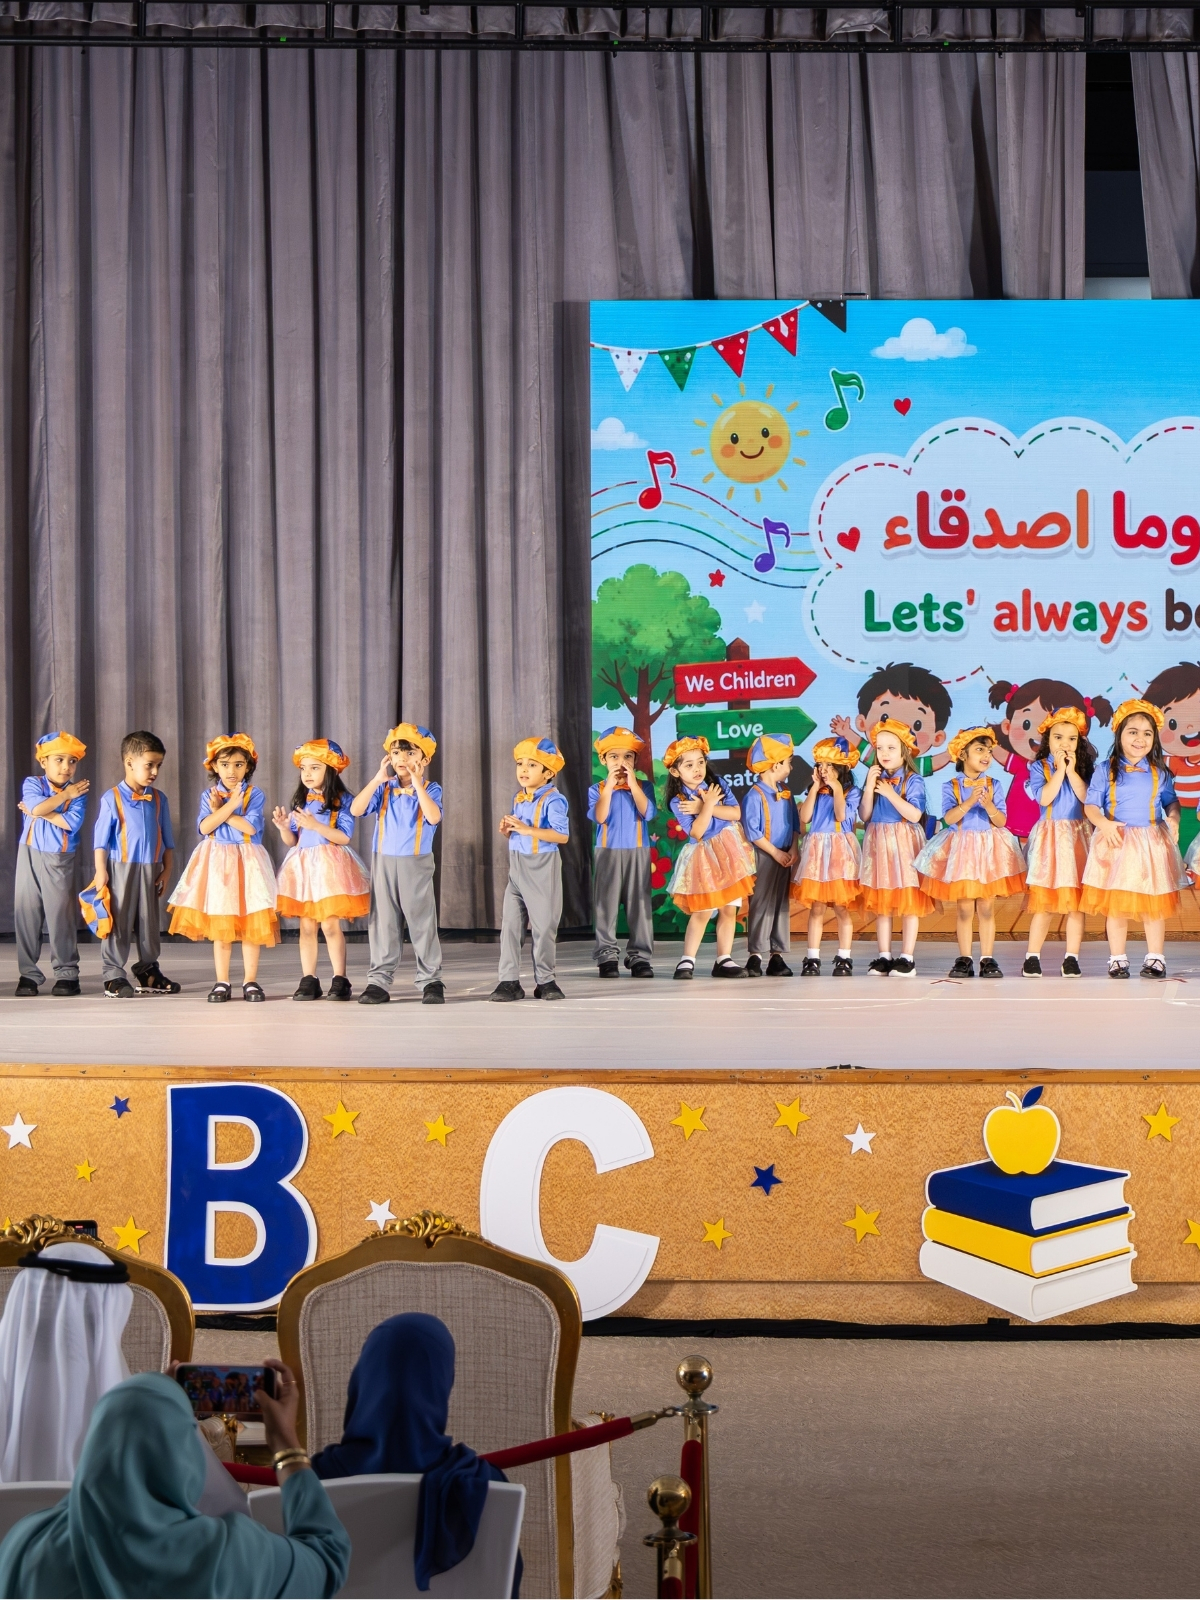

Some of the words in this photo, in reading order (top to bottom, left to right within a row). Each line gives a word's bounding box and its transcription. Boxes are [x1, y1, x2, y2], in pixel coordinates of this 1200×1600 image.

[883, 489, 1089, 549] اصدقاء
[863, 588, 976, 632] Lets'
[993, 588, 1149, 644] always
[684, 674, 715, 693] We
[719, 670, 796, 691] Children
[717, 720, 764, 739] Love
[164, 1083, 317, 1312] B
[479, 1086, 660, 1322] C
